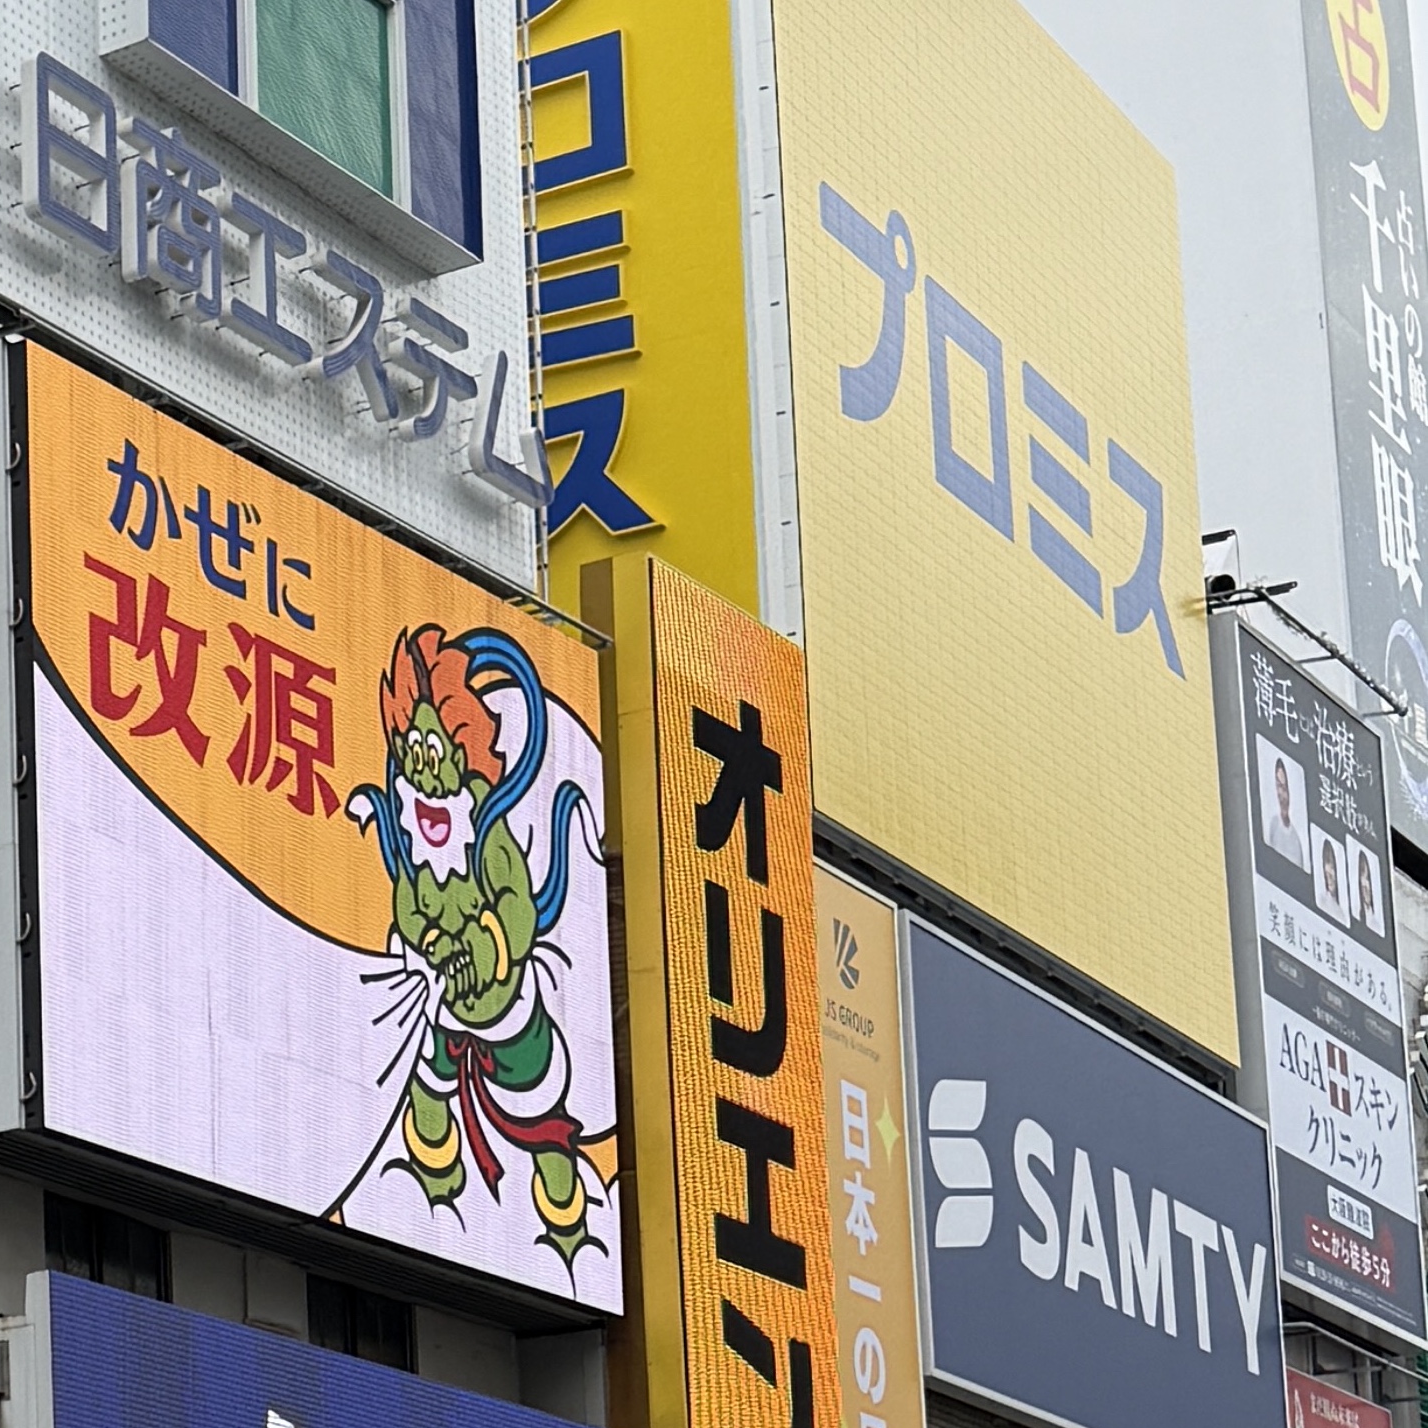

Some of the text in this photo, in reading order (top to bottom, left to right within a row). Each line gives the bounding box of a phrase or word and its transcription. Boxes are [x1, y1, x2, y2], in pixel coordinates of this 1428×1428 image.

[22, 51, 554, 508] 日商エステム
[517, 0, 658, 548] ロミス
[1348, 158, 1423, 607] 千里眼
[107, 438, 316, 632] かぜに
[819, 180, 1186, 681] プロミス
[84, 553, 347, 819] 改源
[839, 1005, 875, 1038] GROUP
[1279, 1023, 1327, 1093] AGA
[1354, 1073, 1399, 1131] スキン
[1307, 1106, 1384, 1190] クリニック
[1013, 1117, 1268, 1377] SAMTY
[1310, 1221, 1391, 1290] ここから徒歩5分
